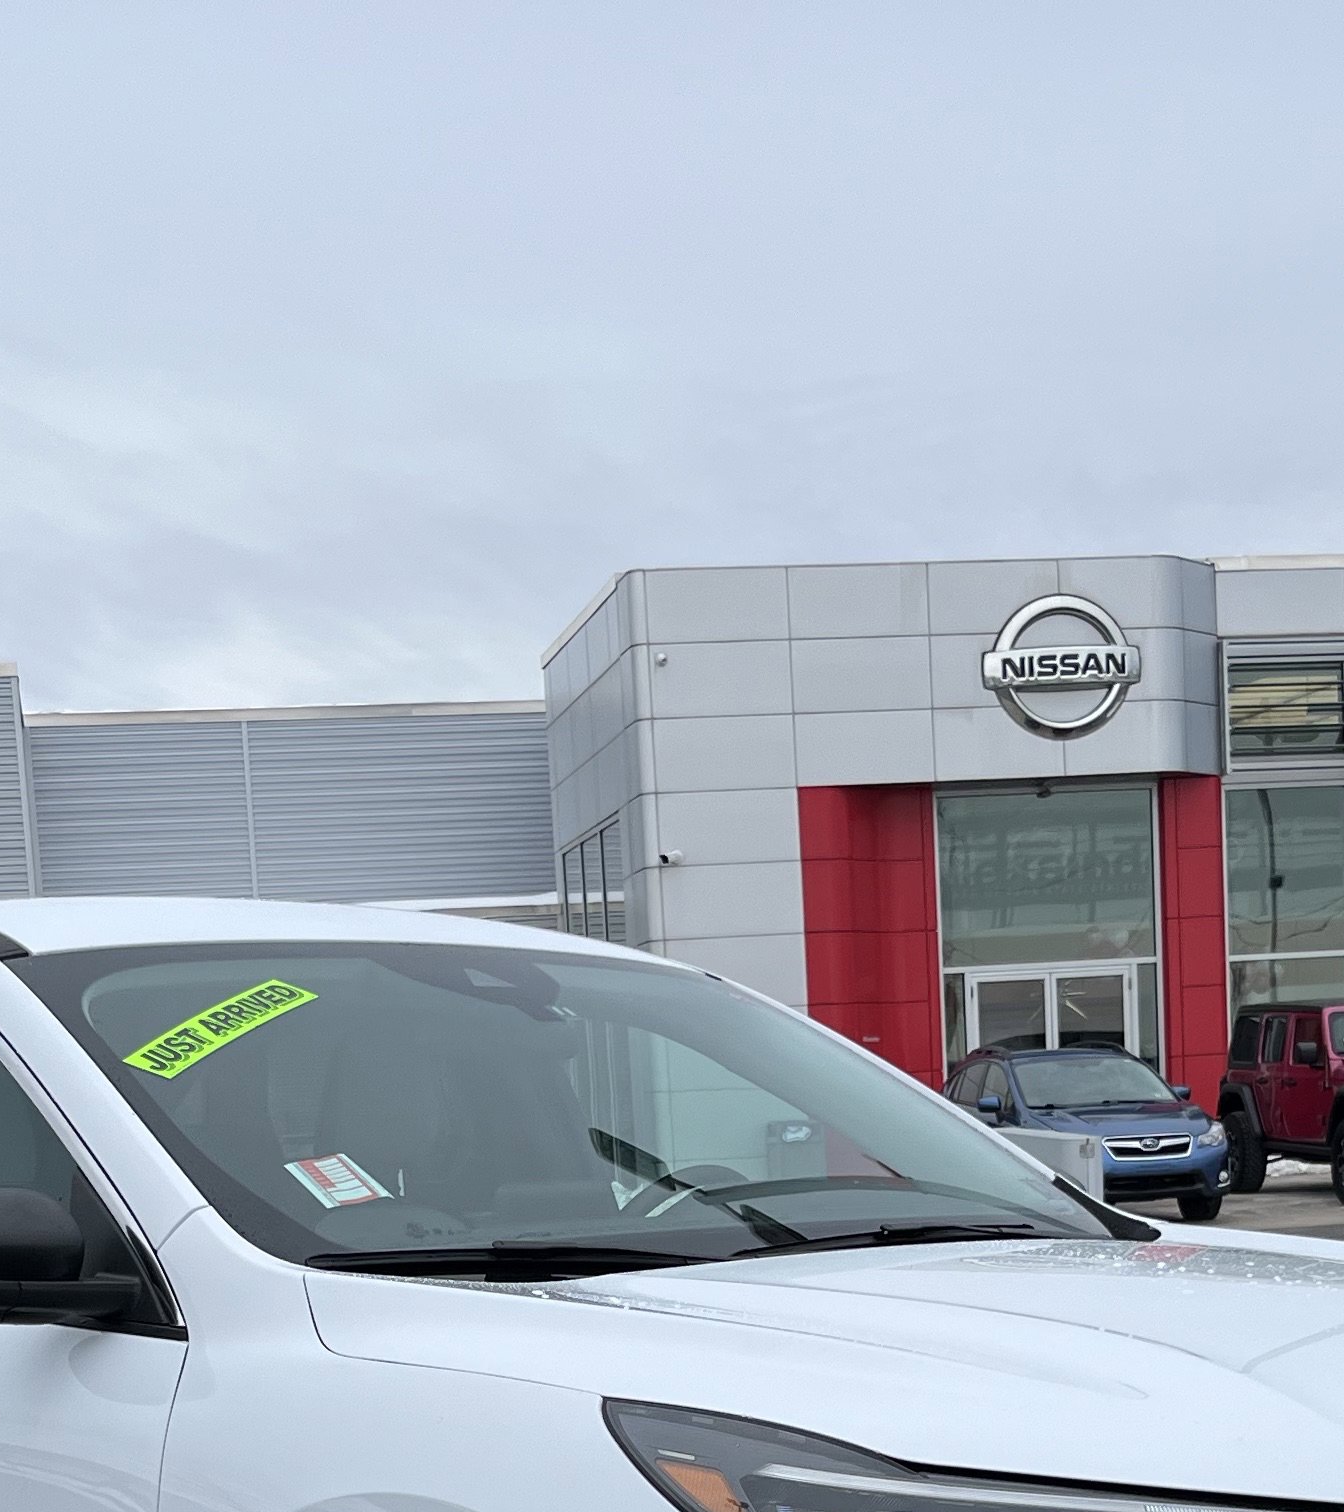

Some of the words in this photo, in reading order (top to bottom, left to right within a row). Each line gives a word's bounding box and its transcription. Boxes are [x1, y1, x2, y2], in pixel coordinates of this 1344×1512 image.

[1001, 653, 1127, 680] NISSAN
[140, 1026, 213, 1071] JUST
[198, 984, 304, 1037] ARRIVED
